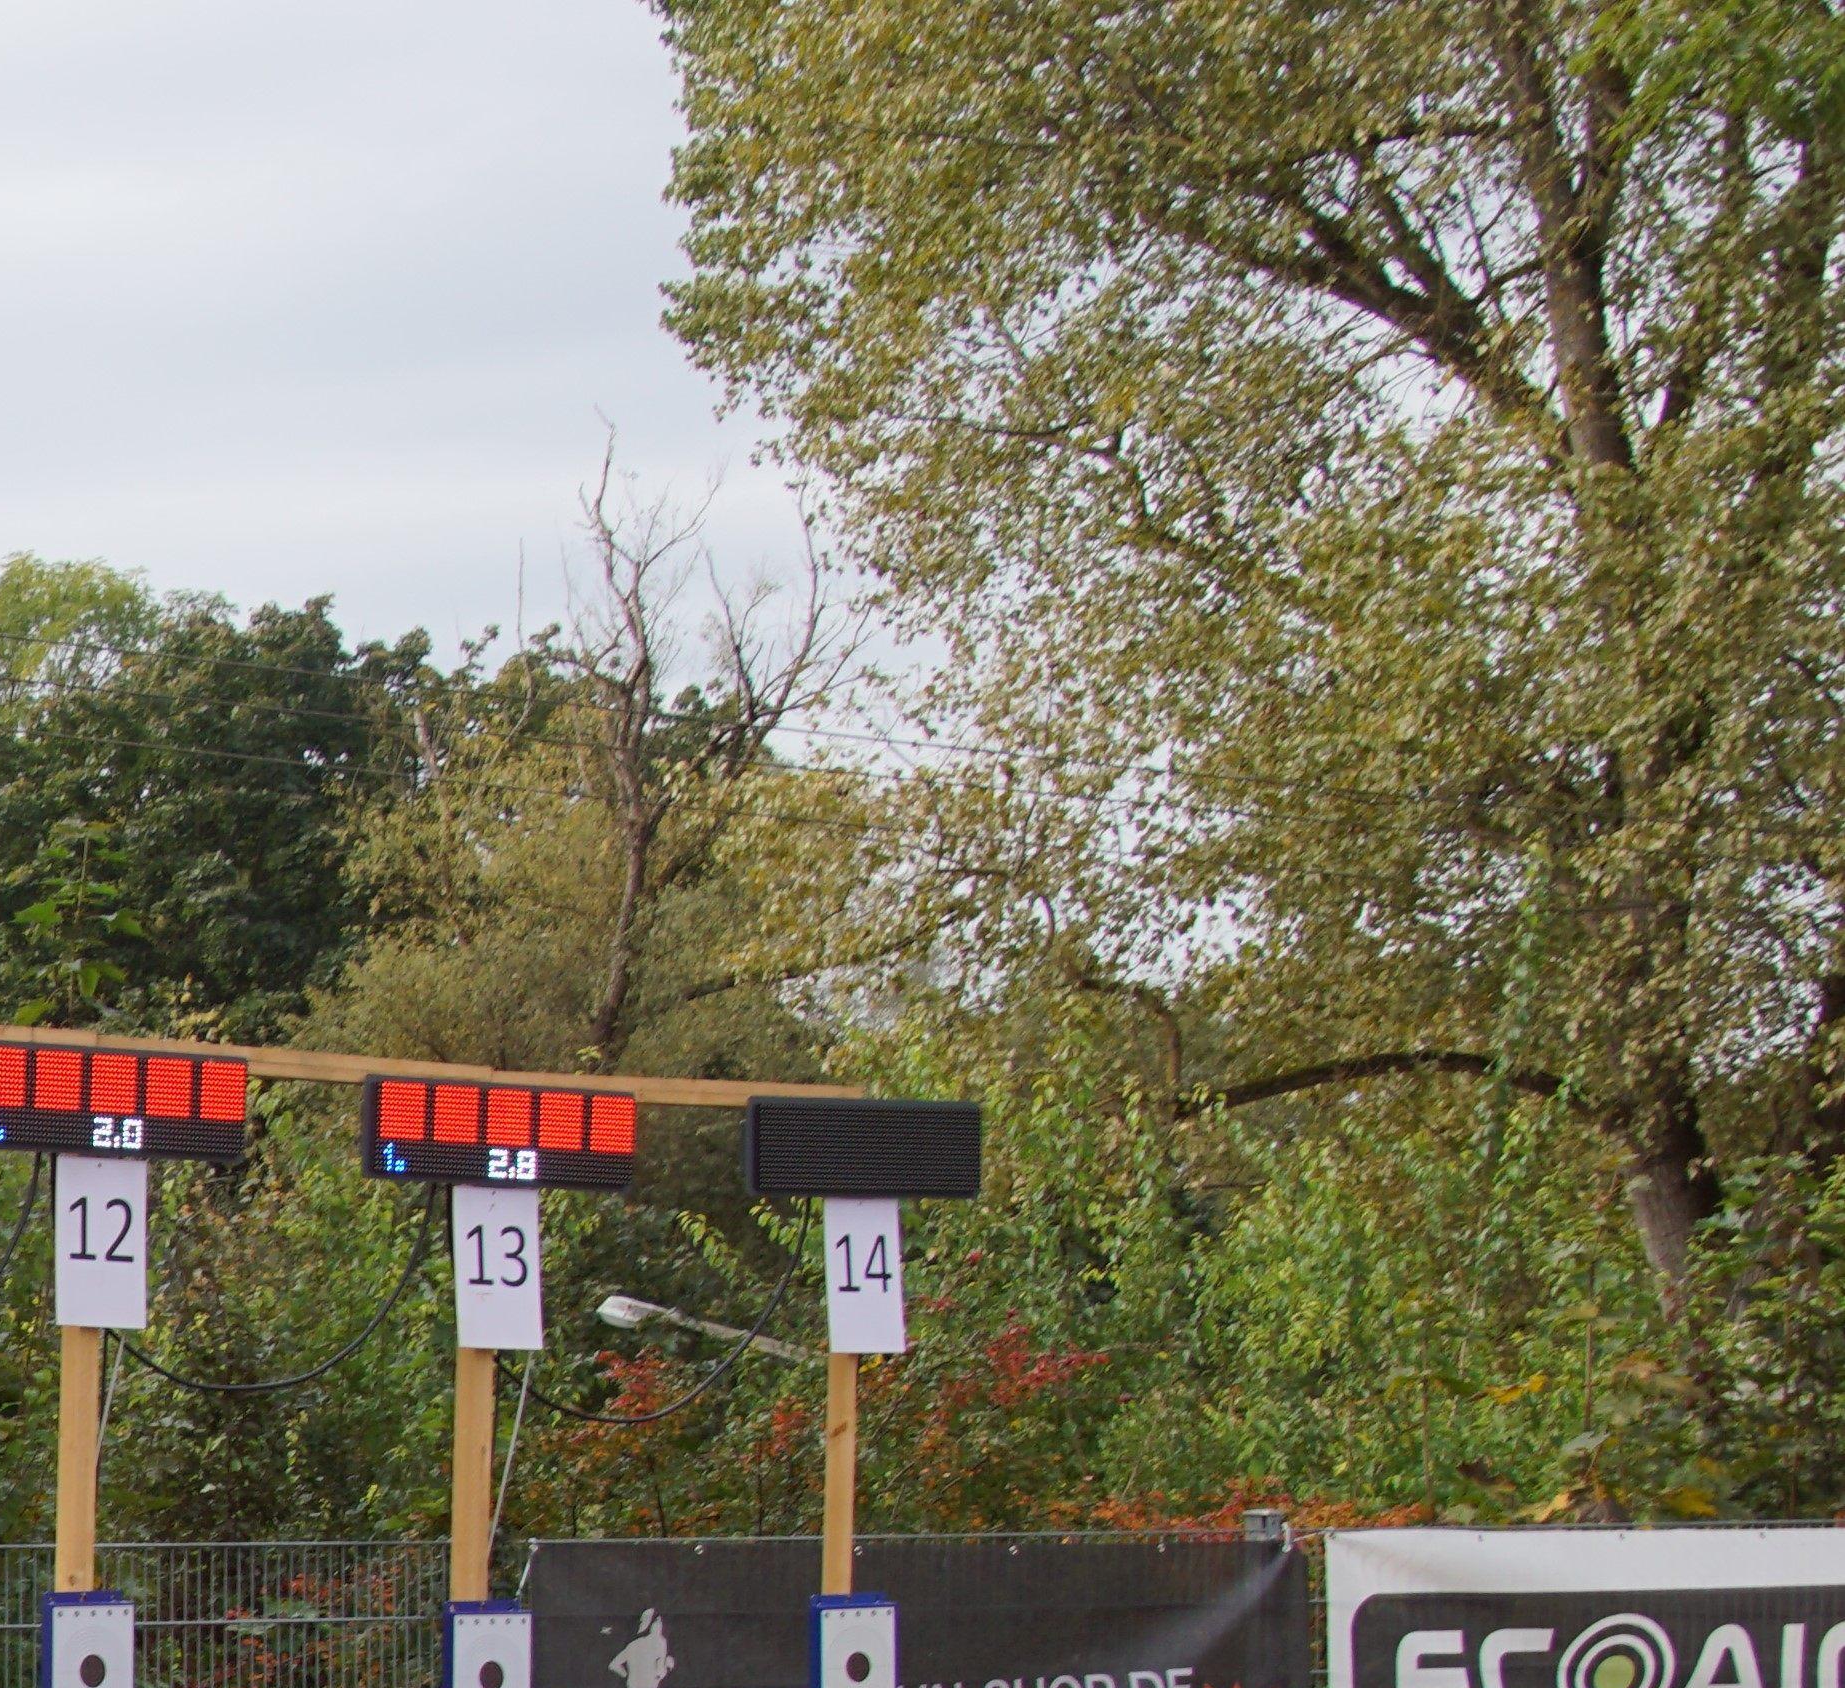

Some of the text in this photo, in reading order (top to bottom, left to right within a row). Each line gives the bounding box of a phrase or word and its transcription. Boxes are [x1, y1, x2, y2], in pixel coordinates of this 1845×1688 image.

[68, 1196, 135, 1263] 12
[466, 1224, 529, 1288] 13
[835, 1233, 892, 1293] 14
